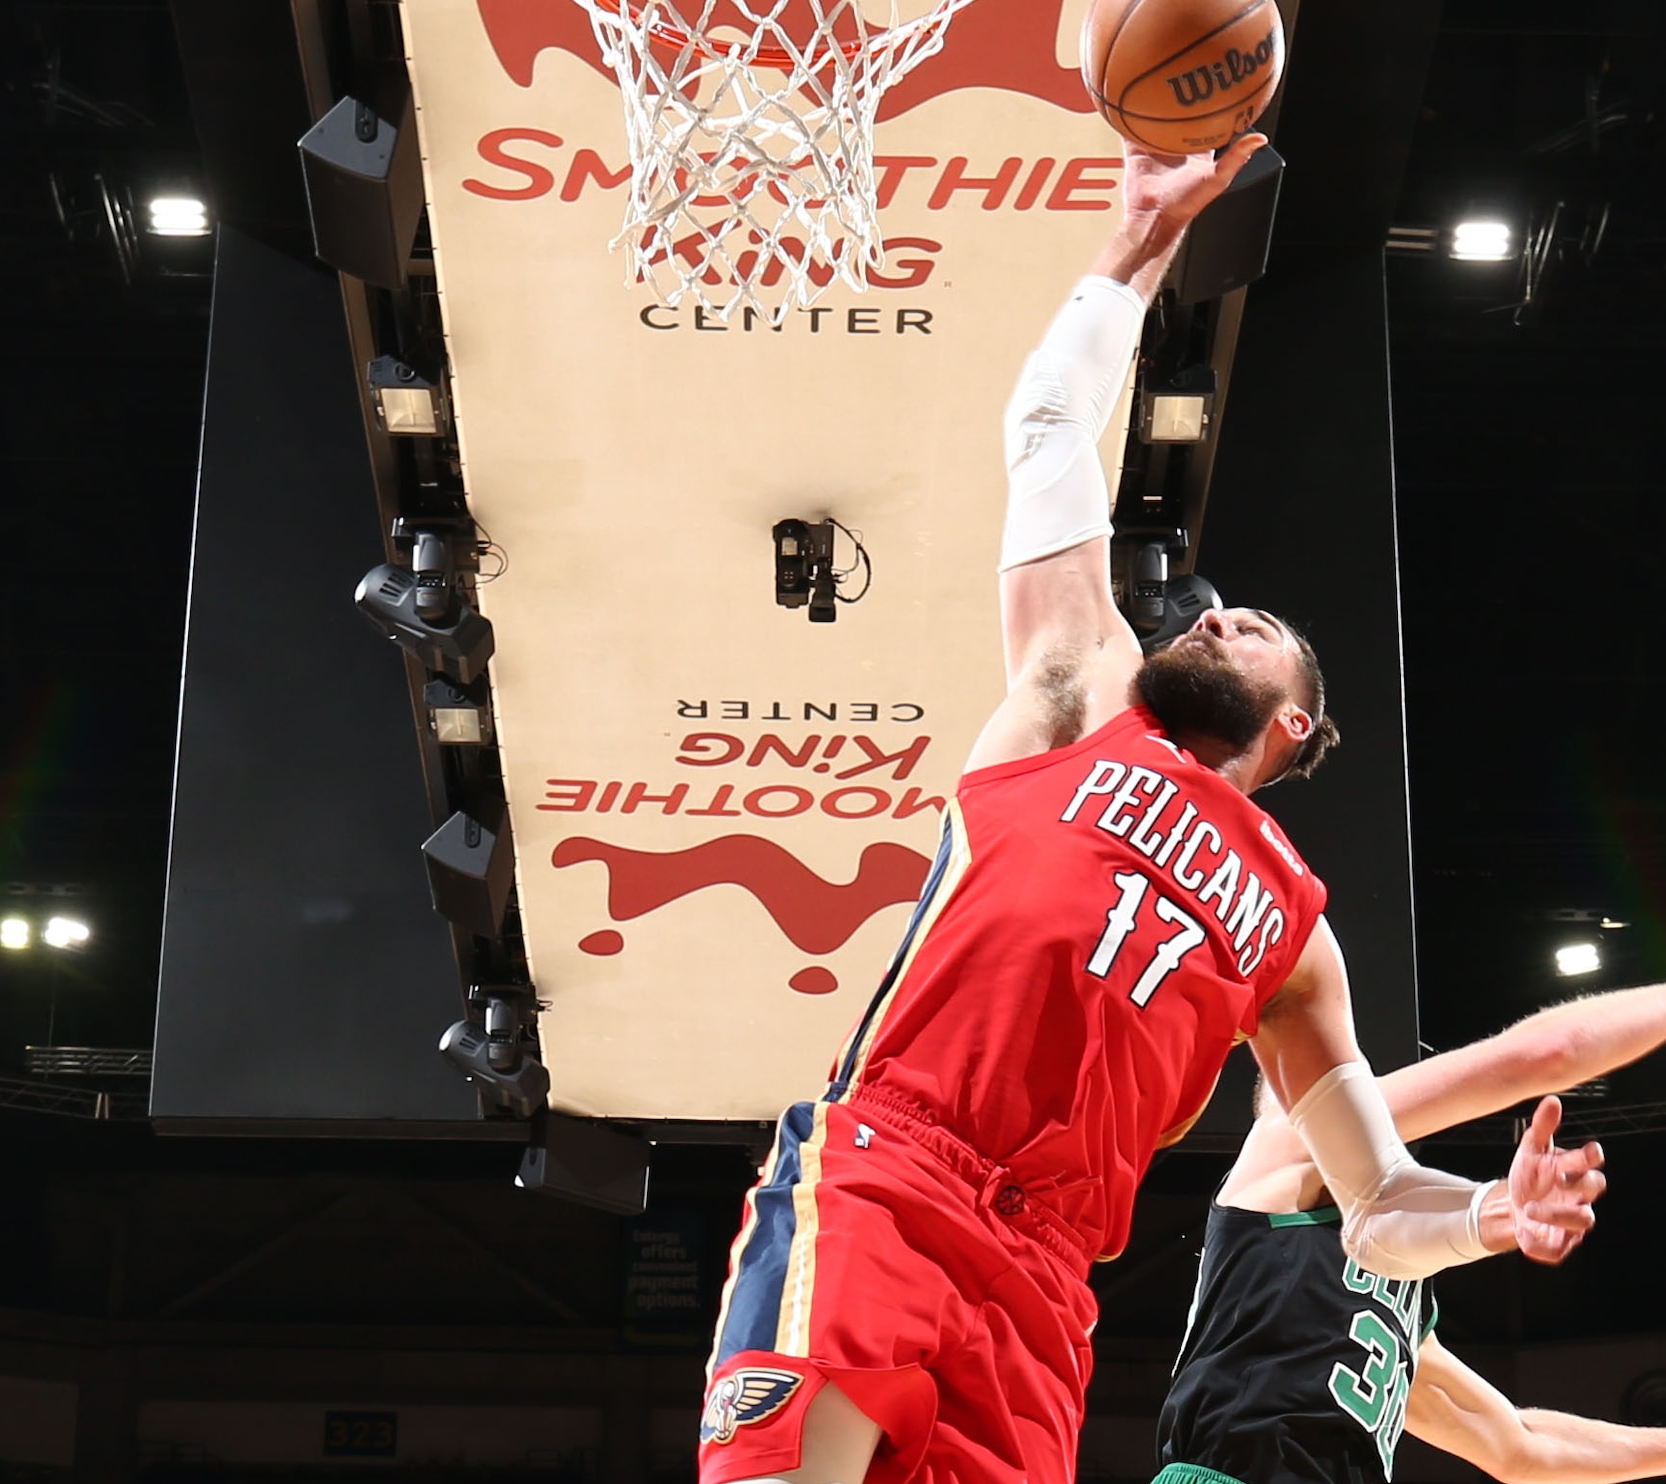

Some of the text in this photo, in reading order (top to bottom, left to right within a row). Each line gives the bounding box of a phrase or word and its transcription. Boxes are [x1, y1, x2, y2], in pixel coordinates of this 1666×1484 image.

[639, 304, 934, 335] CENTER
[676, 699, 925, 722] CENTER
[535, 779, 948, 820] MOOTHIE
[1059, 758, 1285, 978] PELICANS
[1086, 870, 1208, 1010] 17
[328, 1418, 395, 1449] 323
